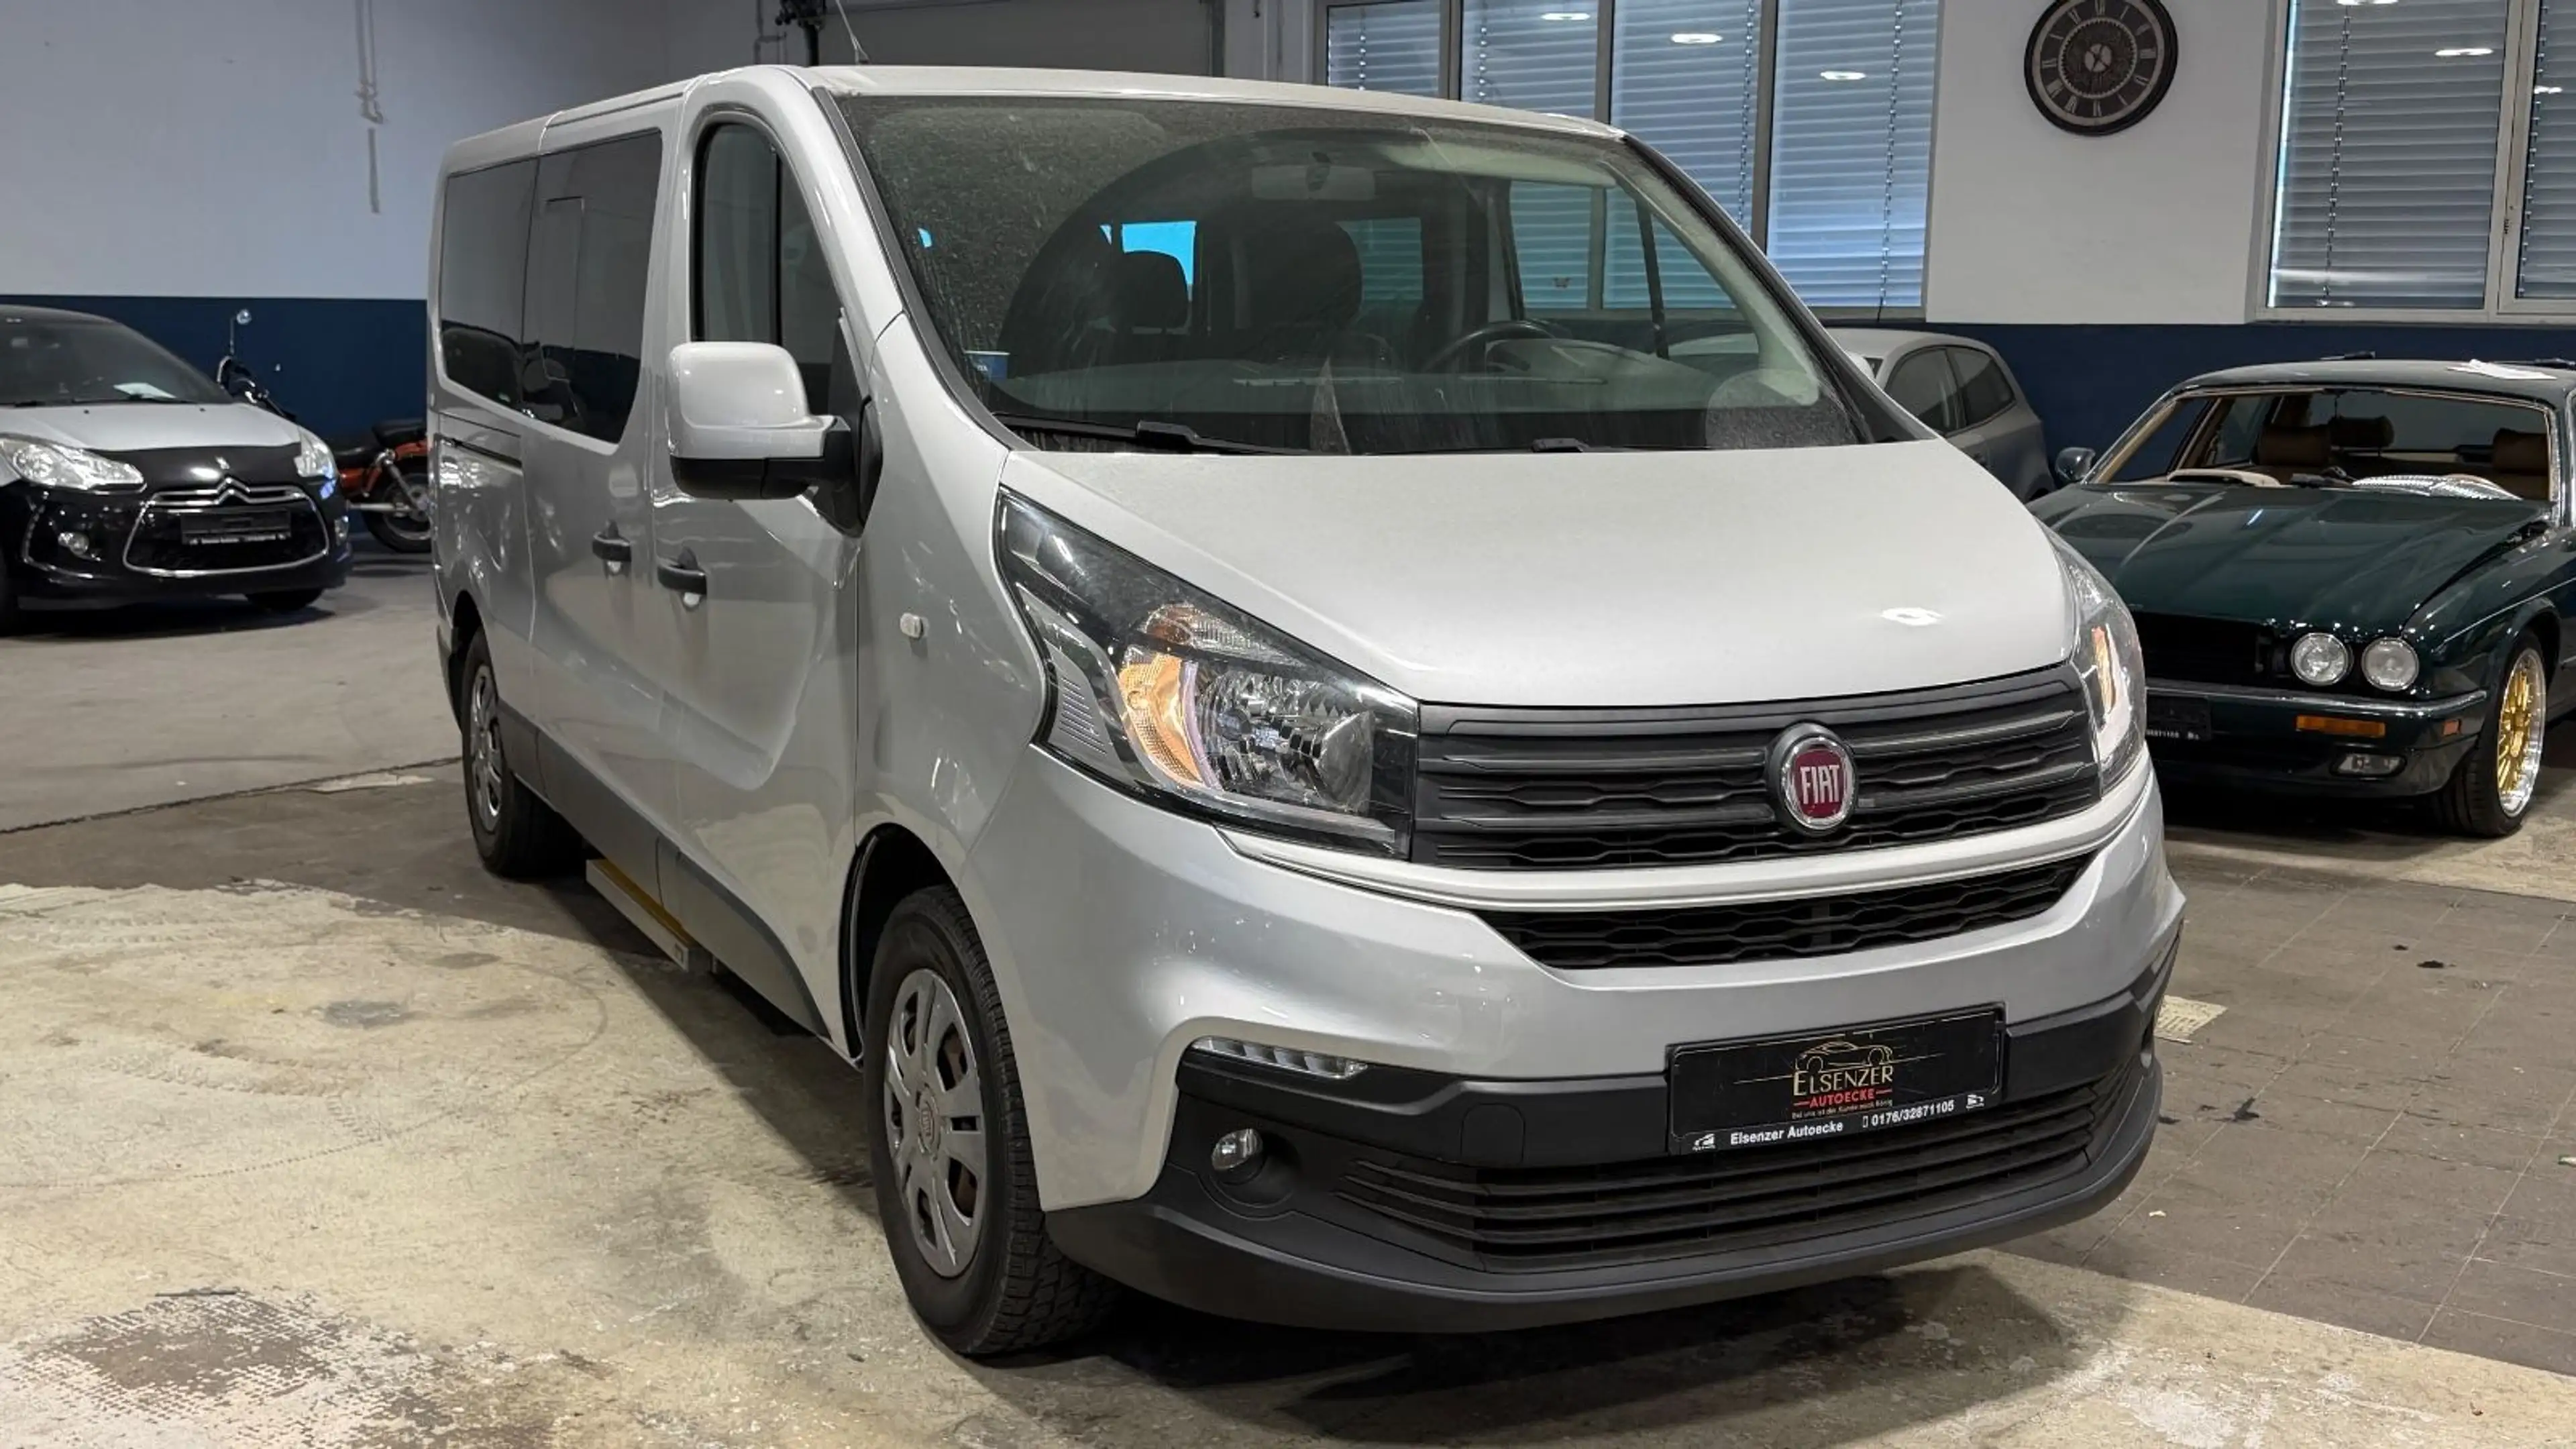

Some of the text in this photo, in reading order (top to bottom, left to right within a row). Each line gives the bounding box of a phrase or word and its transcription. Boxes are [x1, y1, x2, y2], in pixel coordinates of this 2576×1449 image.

[1800, 765, 1840, 804] FIAT
[1792, 1065, 1894, 1096] ELSENZER
[1809, 1088, 1876, 1108] AUTOECKE
[1730, 1099, 1955, 1145] Elsenzer Autoecke 0176/32871105
